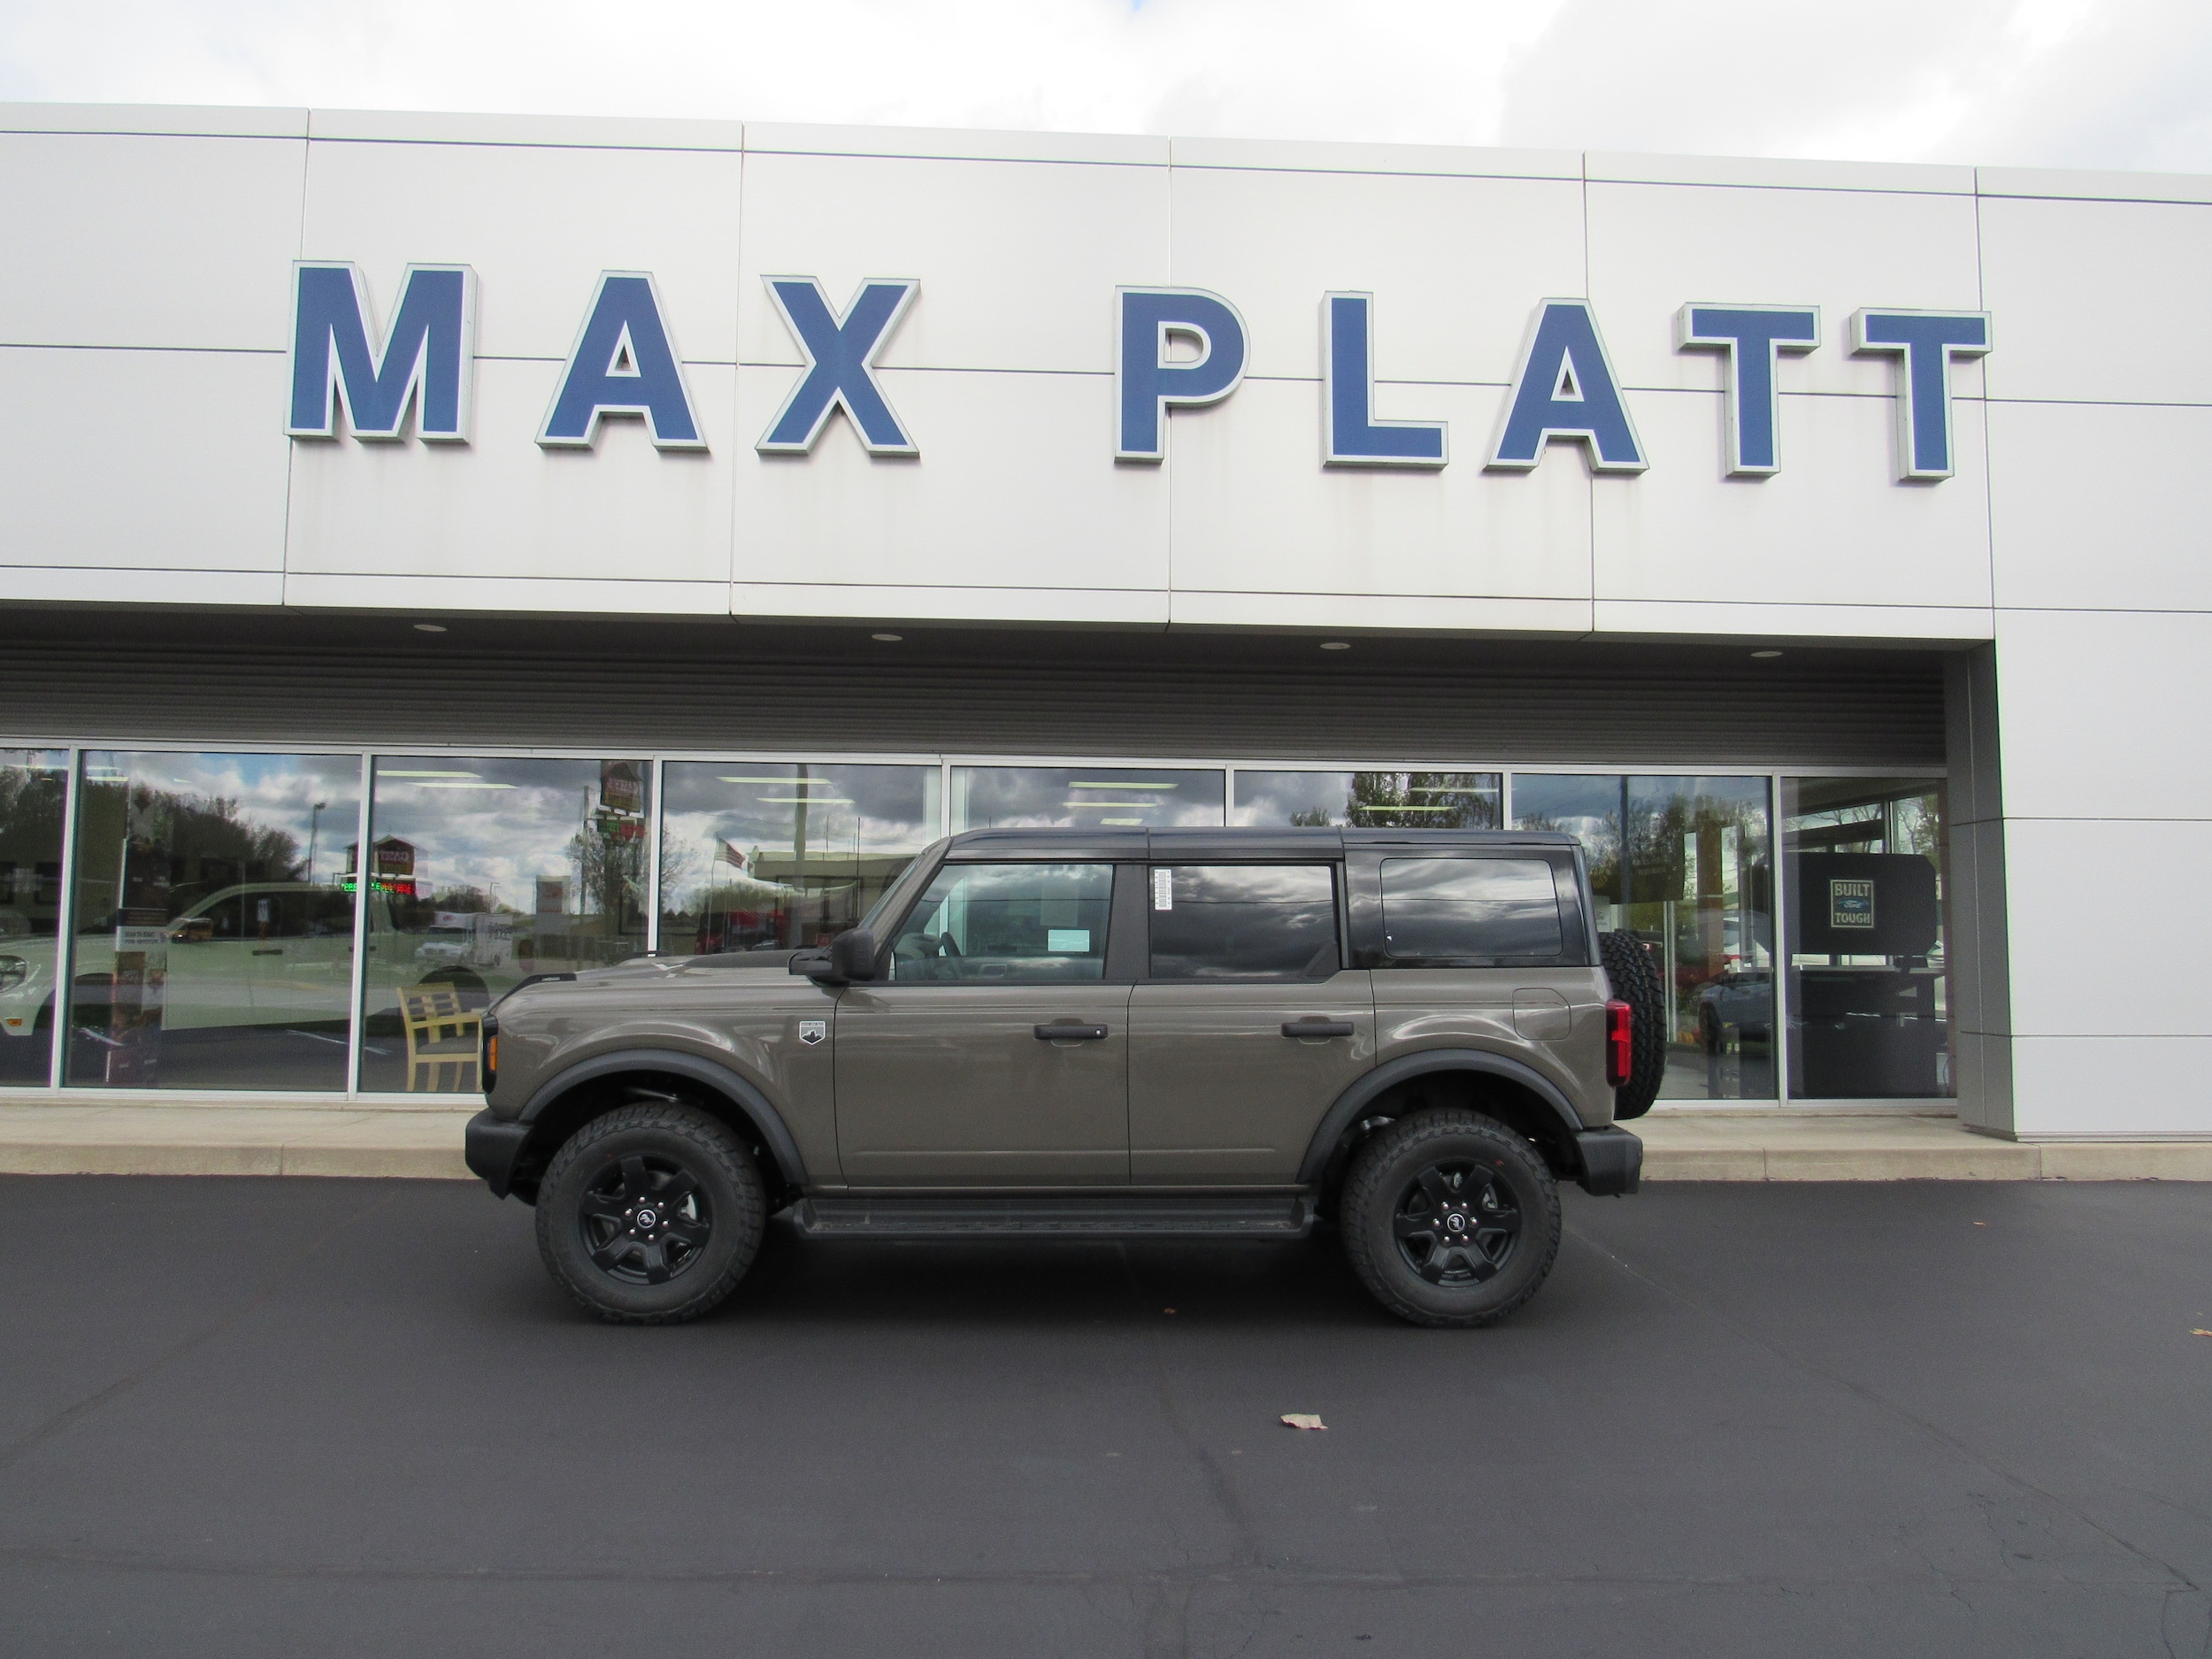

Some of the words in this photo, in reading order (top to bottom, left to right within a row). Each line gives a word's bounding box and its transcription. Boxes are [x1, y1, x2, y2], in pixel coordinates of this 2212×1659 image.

[283, 259, 920, 457] MAX
[1114, 285, 1993, 482] PLATT
[1834, 883, 1870, 896] BUILT
[1834, 912, 1870, 924] TOUGH
